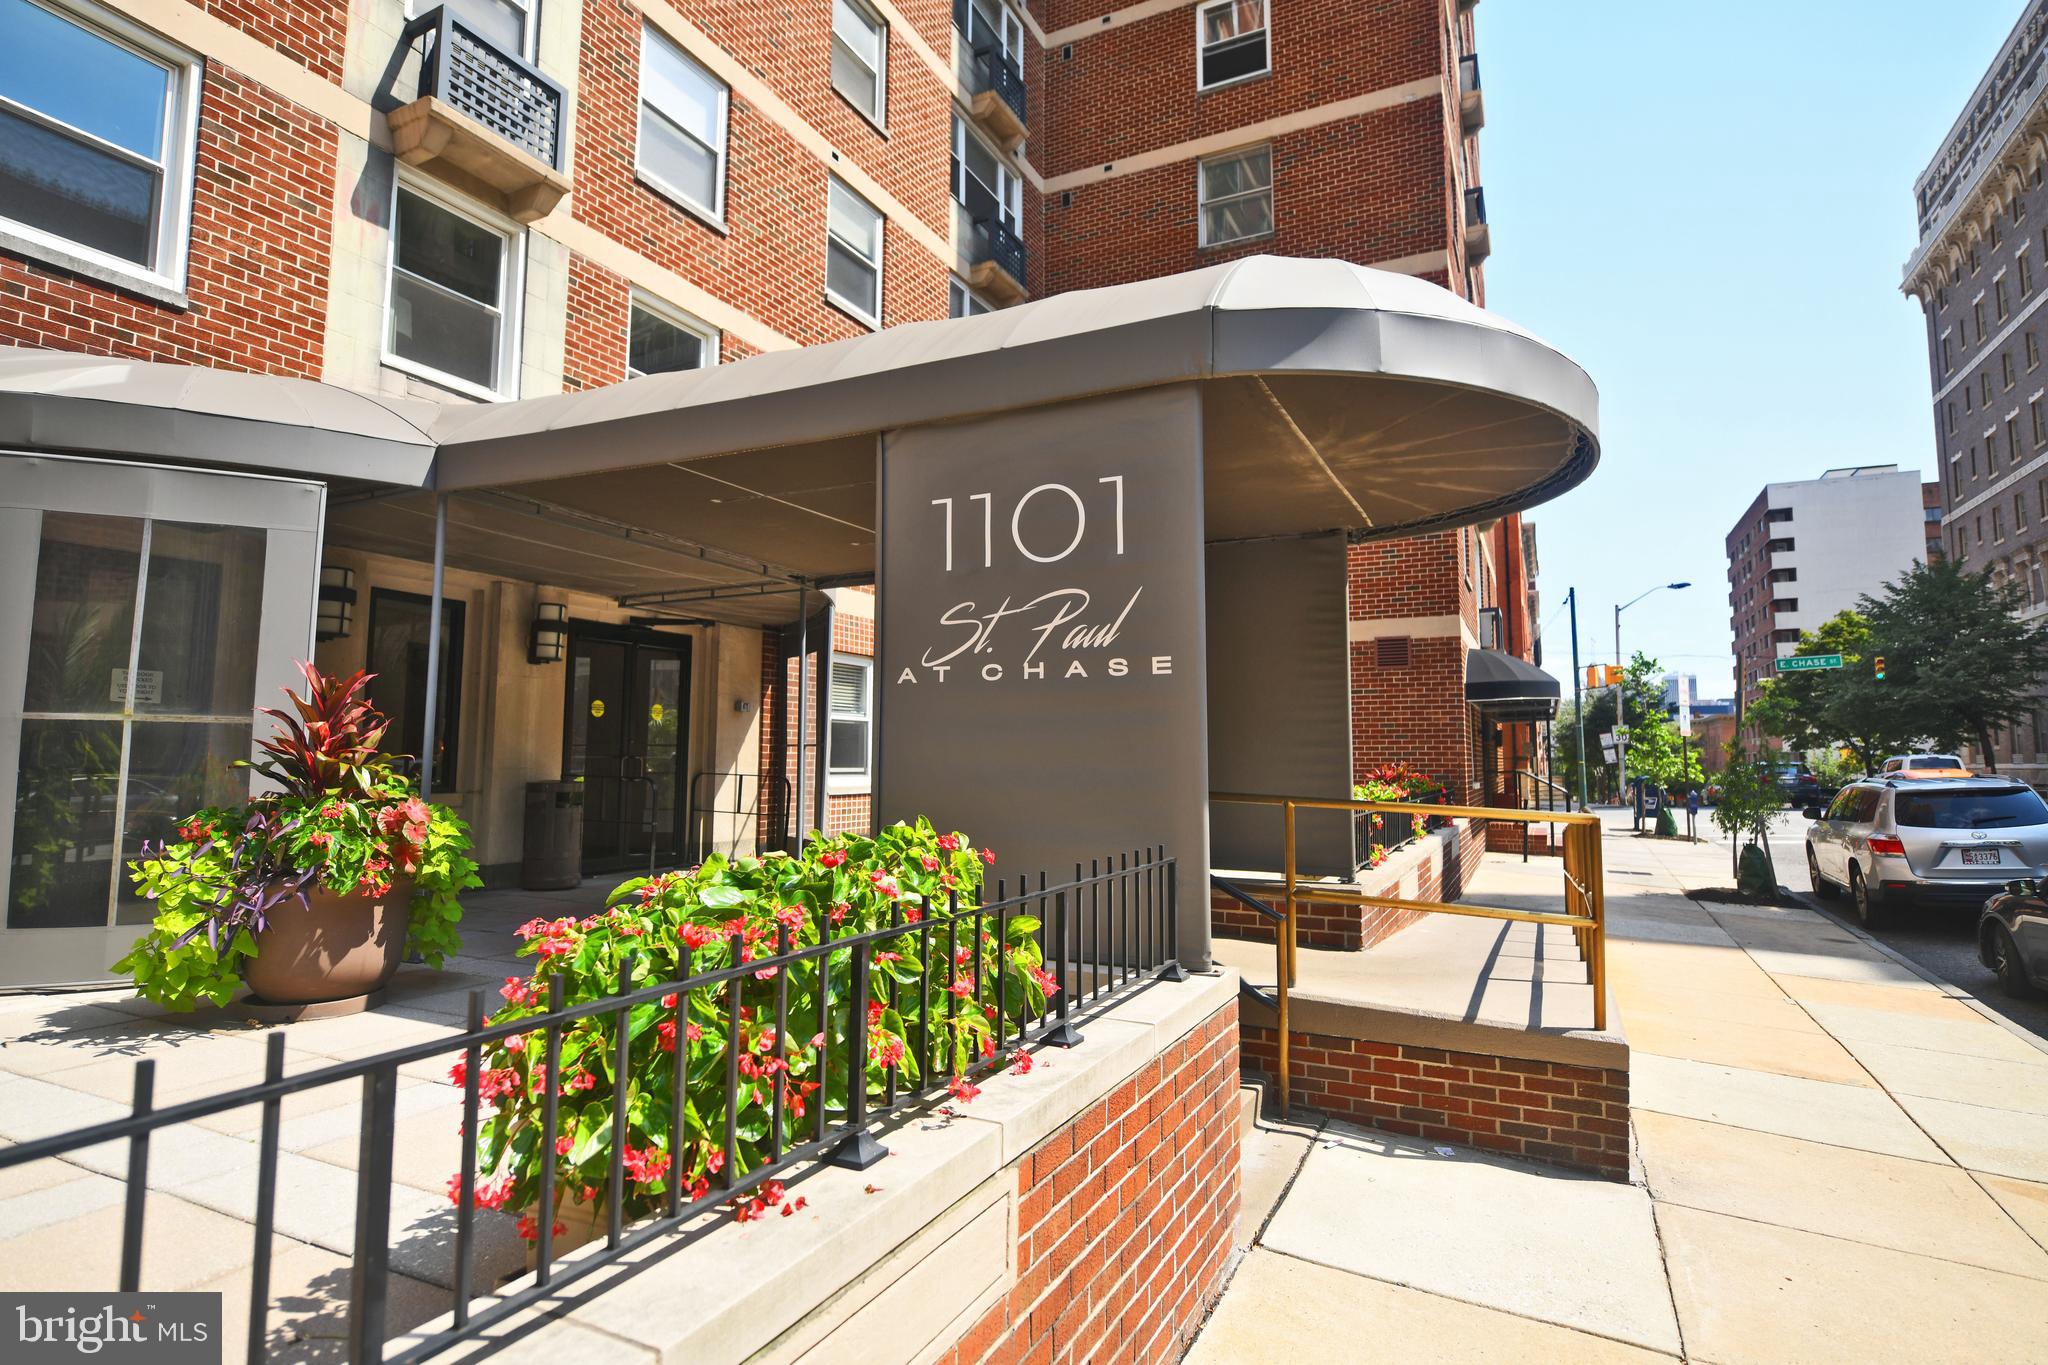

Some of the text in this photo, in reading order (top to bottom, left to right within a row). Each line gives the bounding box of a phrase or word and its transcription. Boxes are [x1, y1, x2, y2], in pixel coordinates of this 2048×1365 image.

[932, 475, 1124, 572] 1101
[921, 586, 1143, 668] St. Paul
[897, 656, 1173, 684] AT CHASE
[1780, 660, 1789, 668] E.
[1791, 658, 1827, 668] CHASE
[1615, 733, 1628, 742] 30
